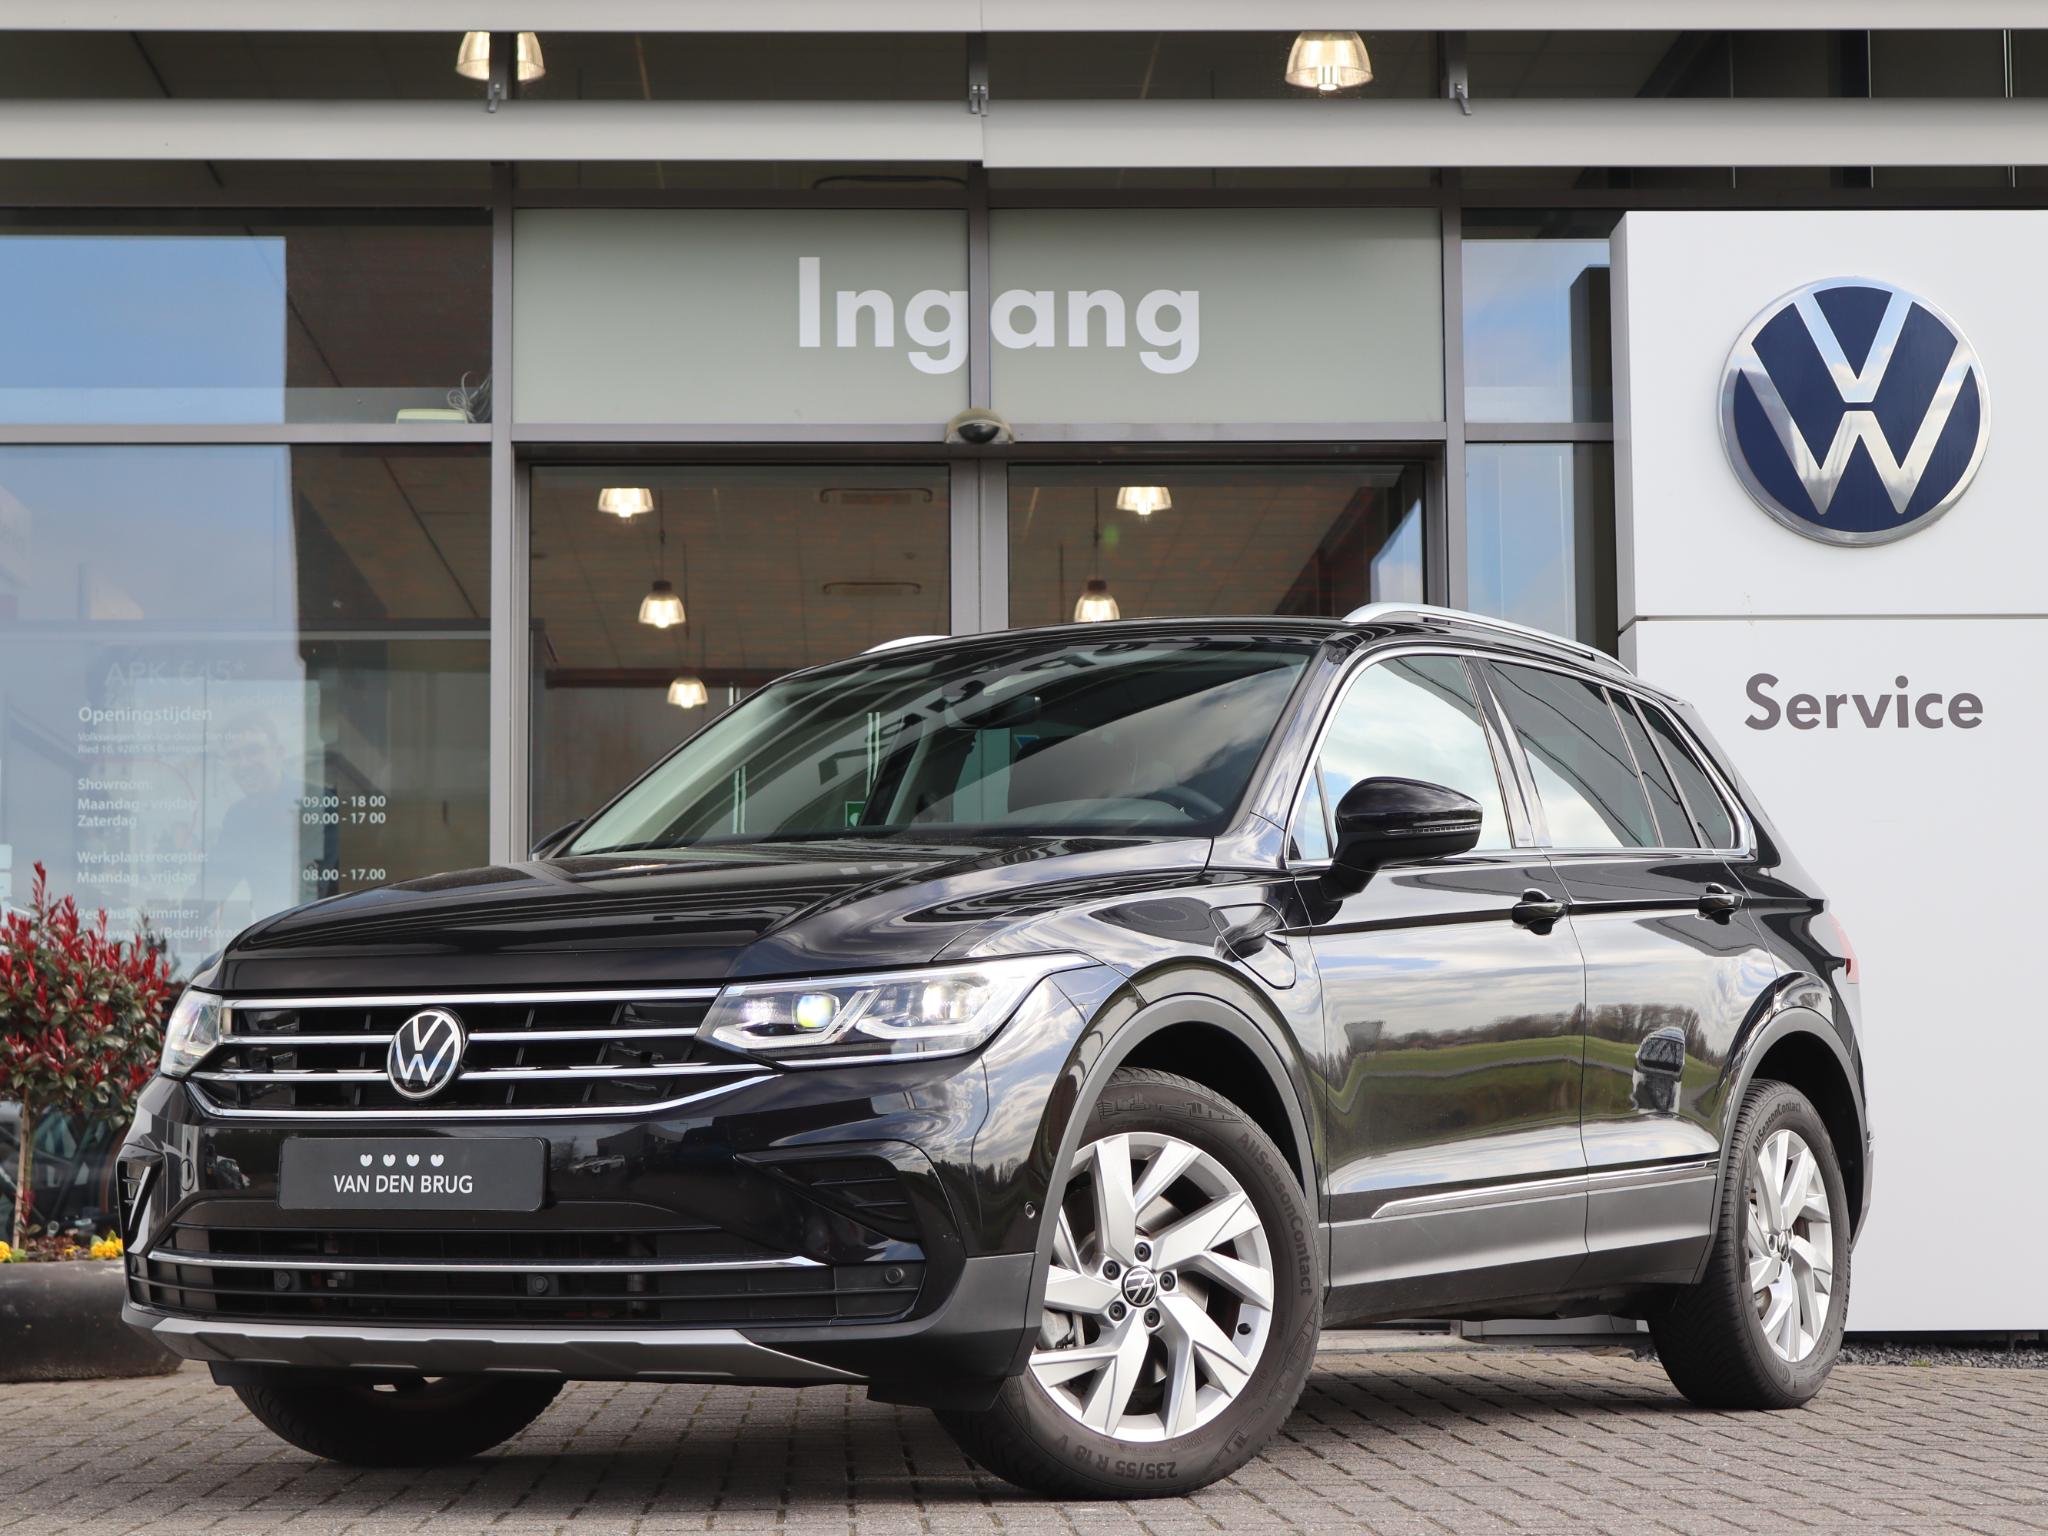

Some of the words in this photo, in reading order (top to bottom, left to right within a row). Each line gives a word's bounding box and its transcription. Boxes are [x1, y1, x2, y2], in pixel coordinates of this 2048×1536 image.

[798, 256, 1201, 375] Ingang
[1744, 672, 1984, 731] Service
[78, 705, 213, 726] Openingstijden
[77, 798, 140, 813] Maandag
[302, 795, 339, 808] 09.00
[77, 814, 137, 828] Zaterdag
[302, 811, 339, 825] 09.00
[77, 871, 139, 885] Maandag
[302, 868, 339, 881] 08.00
[350, 868, 387, 881] 17.00
[333, 1174, 370, 1193] VAN
[375, 1174, 415, 1193] DEN
[420, 1174, 473, 1194] BRUG
[1098, 1453, 1109, 1472] R
[1115, 1460, 1178, 1480] 235/55
